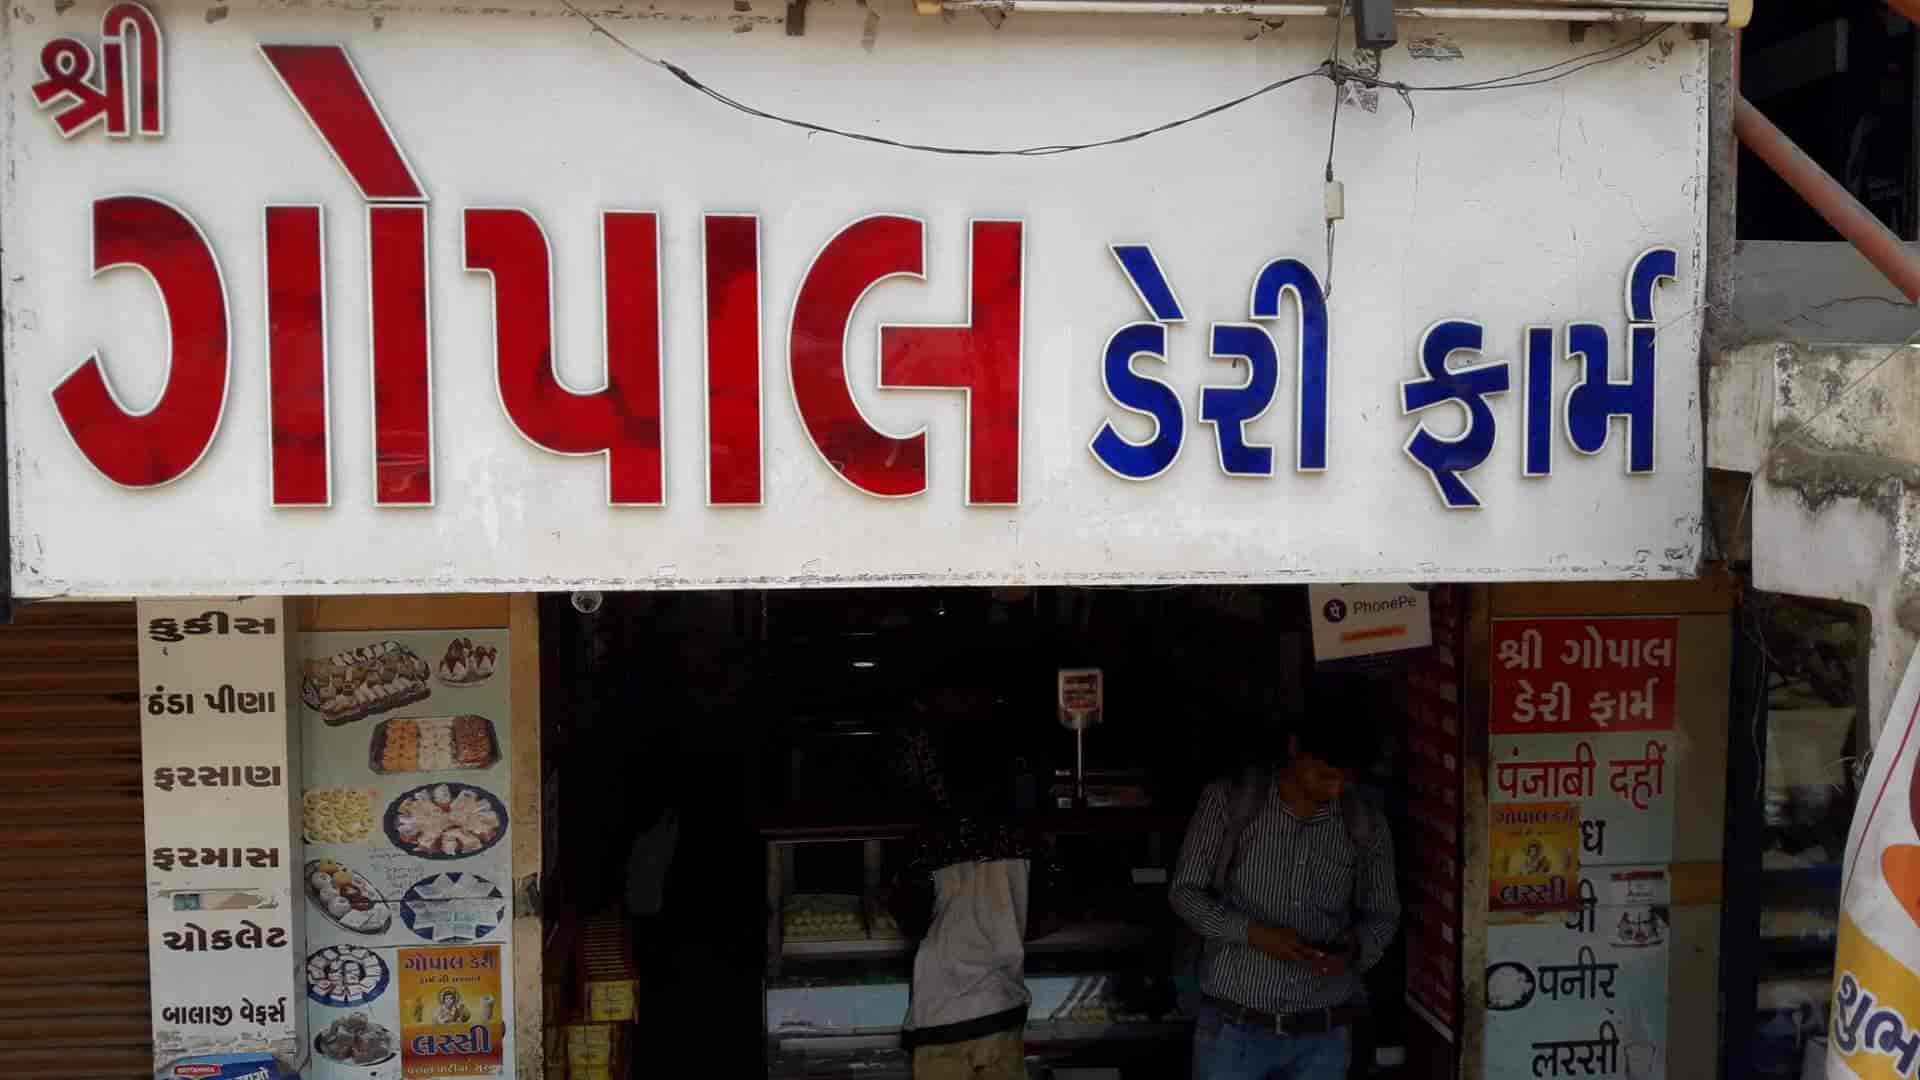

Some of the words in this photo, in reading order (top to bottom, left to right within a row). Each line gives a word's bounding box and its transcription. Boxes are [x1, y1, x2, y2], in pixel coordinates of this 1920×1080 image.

[31, 1, 164, 138] શ્રી
[52, 42, 1024, 508] ગોપાલ
[1088, 243, 1329, 480] ડેરી
[1400, 246, 1678, 509] ફાર્મ
[1353, 595, 1416, 615] PhonePe
[149, 611, 276, 642] કુકીસ
[1497, 628, 1543, 669] શ્રી
[1560, 625, 1673, 669] ગોપાલ
[148, 684, 194, 715] ઠંડા
[204, 684, 275, 714] પીણા
[1512, 679, 1571, 723] ડેરી
[1589, 677, 1659, 727] ફાર્મ
[154, 766, 281, 792] ફરસાણ
[1496, 741, 1597, 798] पंजाबी
[152, 847, 279, 872] ફરમાસ
[162, 919, 288, 952] ચોકલેટ
[405, 952, 464, 971] ગોપાલ
[1538, 946, 1618, 1000] पनीर
[163, 1005, 232, 1026] બાલાજી
[240, 997, 287, 1026] વેફર્સ
[1835, 974, 1920, 1080] શુભ
[414, 1025, 491, 1056] લસ્સી
